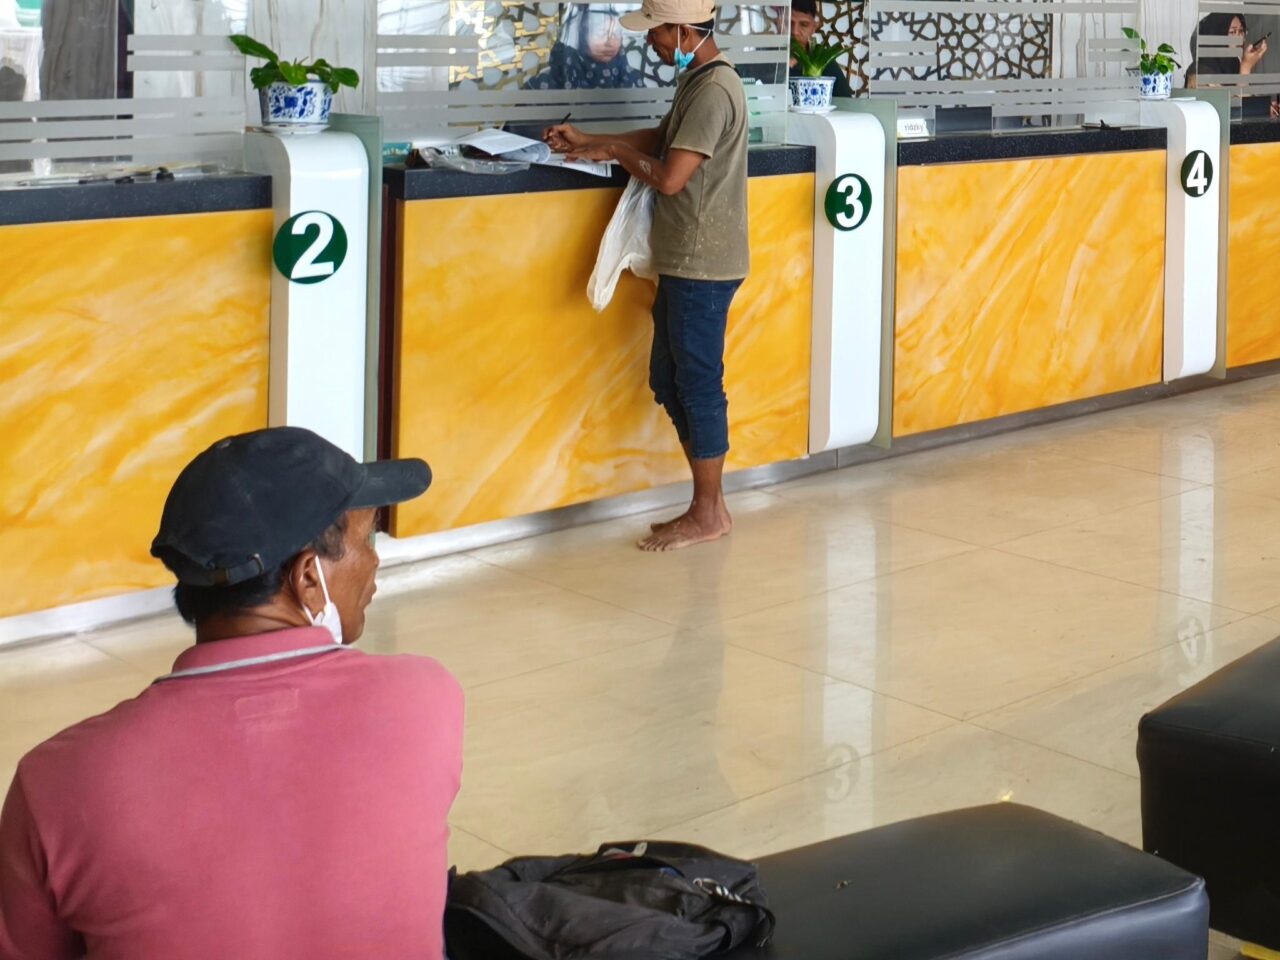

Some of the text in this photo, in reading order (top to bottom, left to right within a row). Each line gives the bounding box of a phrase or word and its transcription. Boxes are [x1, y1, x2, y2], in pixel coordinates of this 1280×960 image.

[1186, 152, 1208, 195] 4
[836, 176, 864, 228] 3
[290, 212, 335, 280] 2
